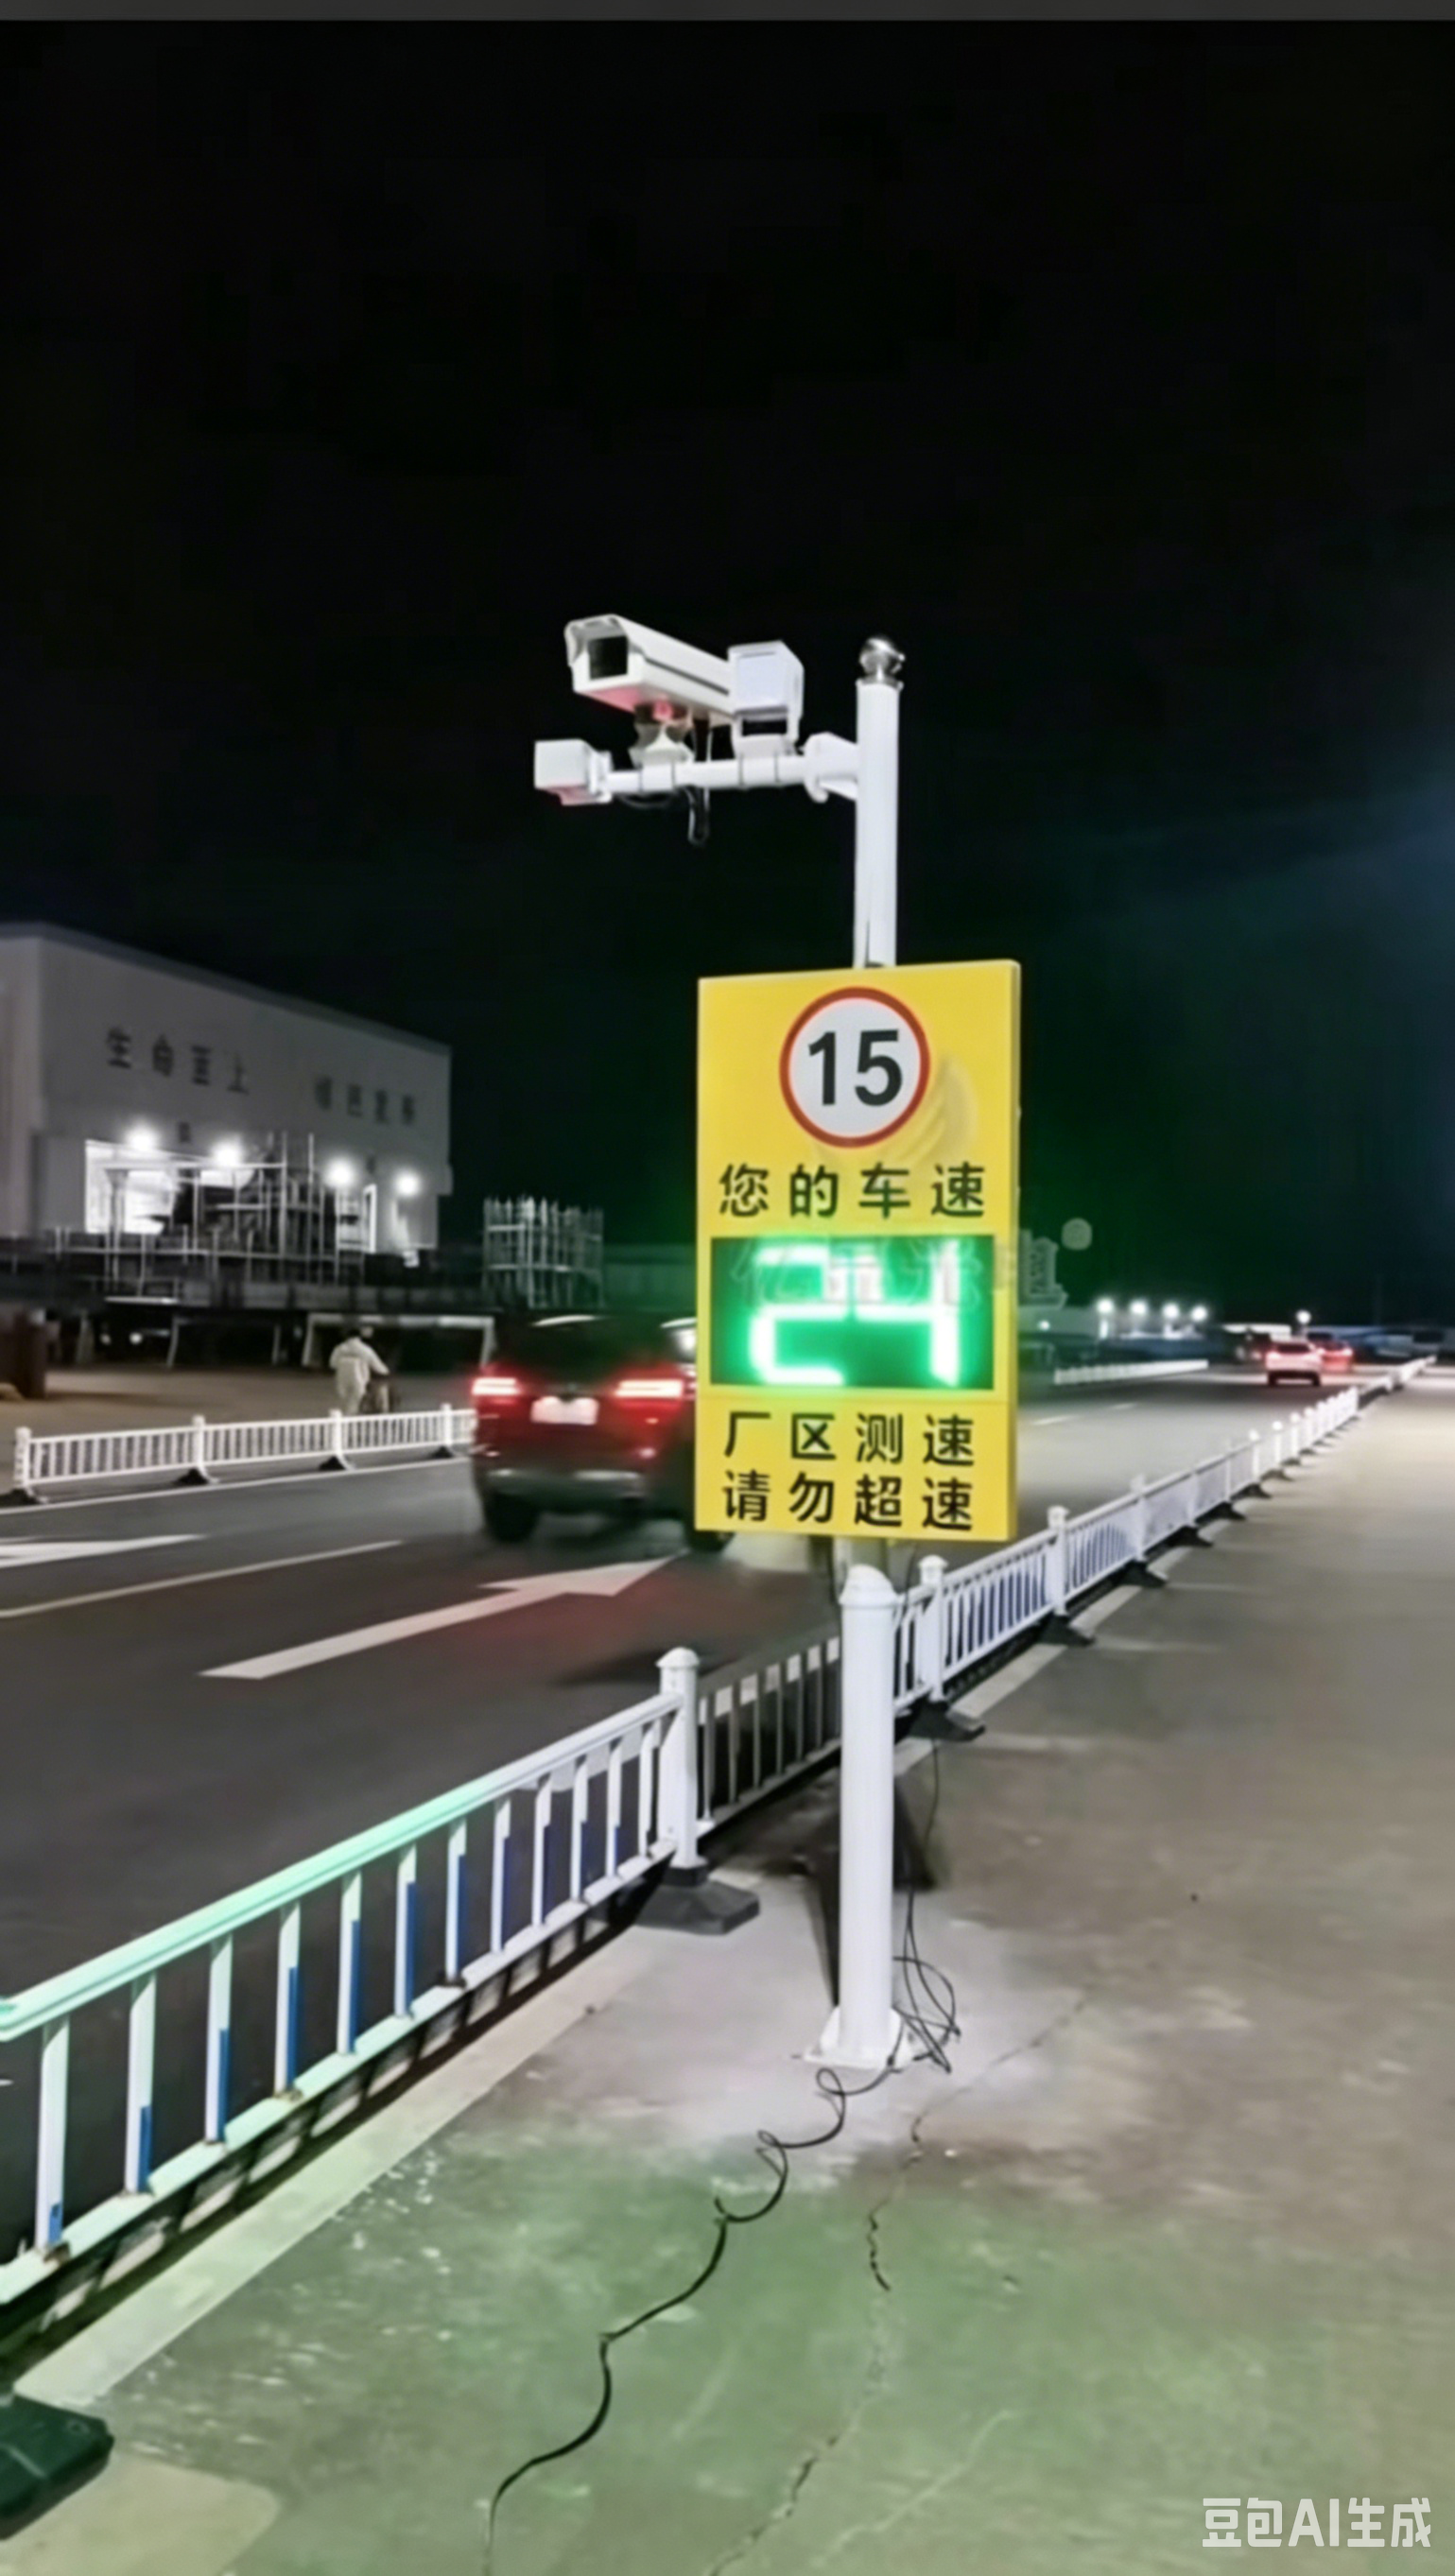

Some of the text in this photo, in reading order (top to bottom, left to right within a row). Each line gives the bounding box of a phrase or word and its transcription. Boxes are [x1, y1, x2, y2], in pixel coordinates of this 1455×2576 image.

[807, 1029, 903, 1107] 15
[718, 1162, 985, 1219] 您的车速
[748, 1237, 961, 1388] 24
[723, 1411, 975, 1466] 厂区测速
[722, 1470, 974, 1530] 请勿超速
